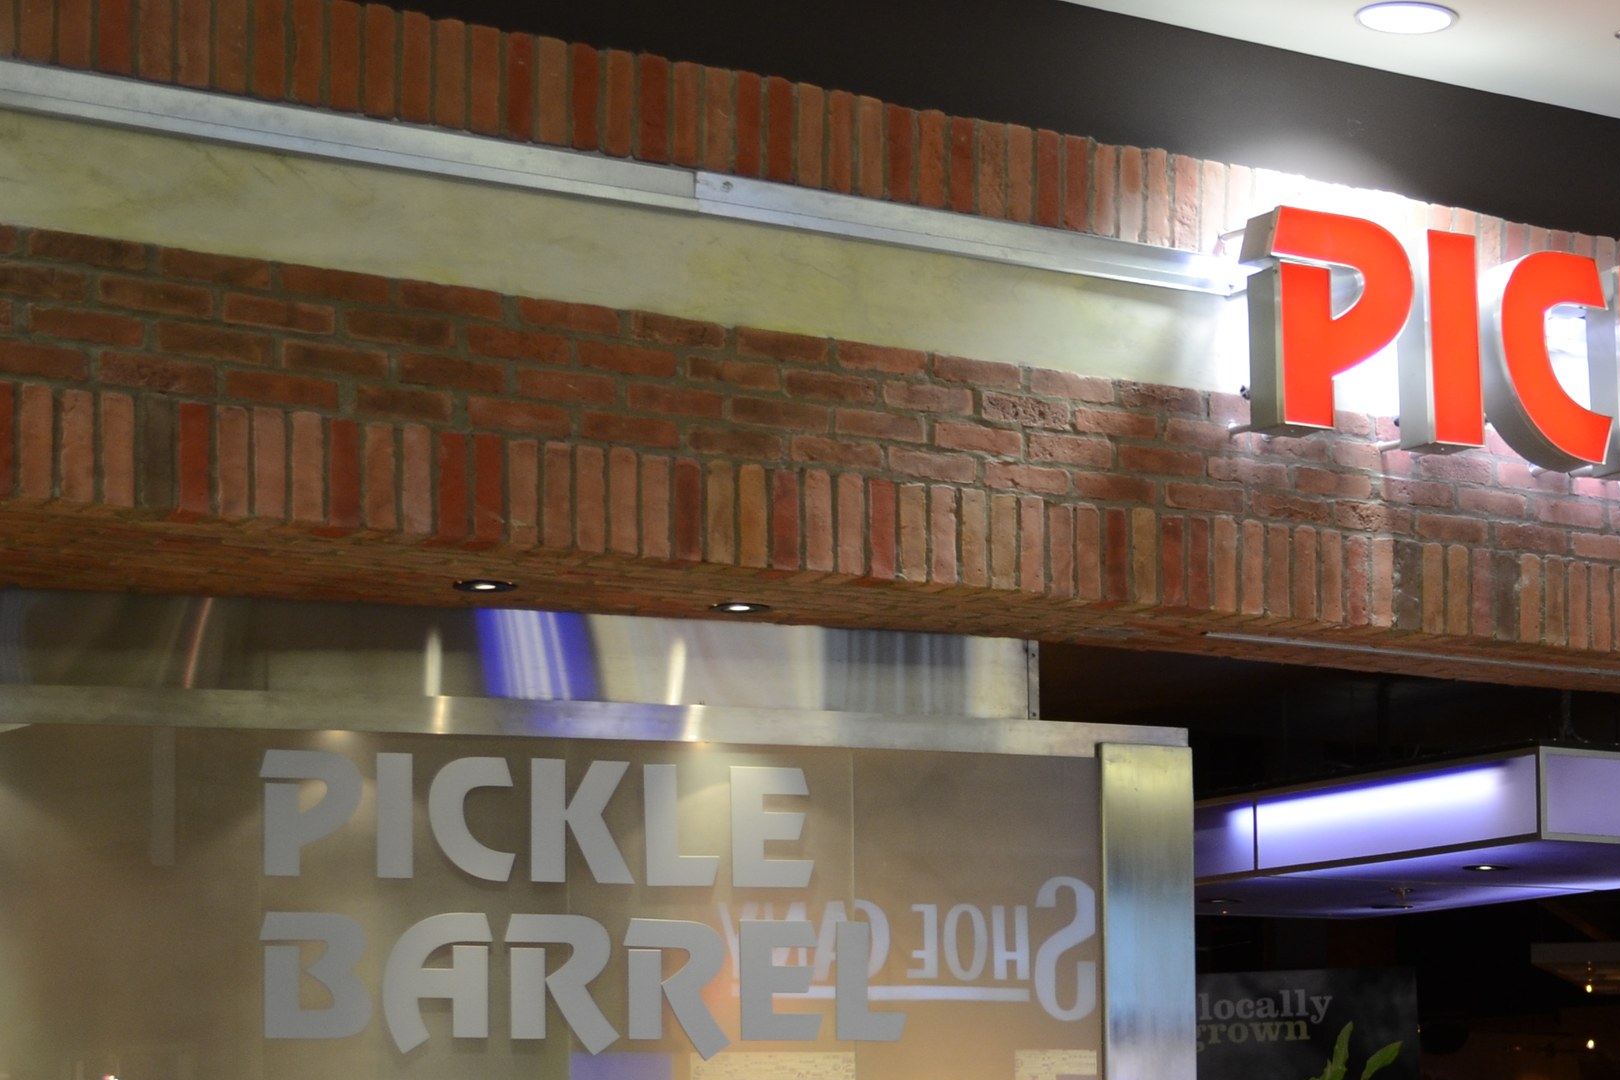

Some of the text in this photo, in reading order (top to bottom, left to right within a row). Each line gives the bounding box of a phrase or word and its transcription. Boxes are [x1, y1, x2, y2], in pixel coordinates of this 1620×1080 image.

[258, 747, 816, 890] PICKLE
[258, 910, 909, 1062] BARREL
[1198, 988, 1334, 1024] locally
